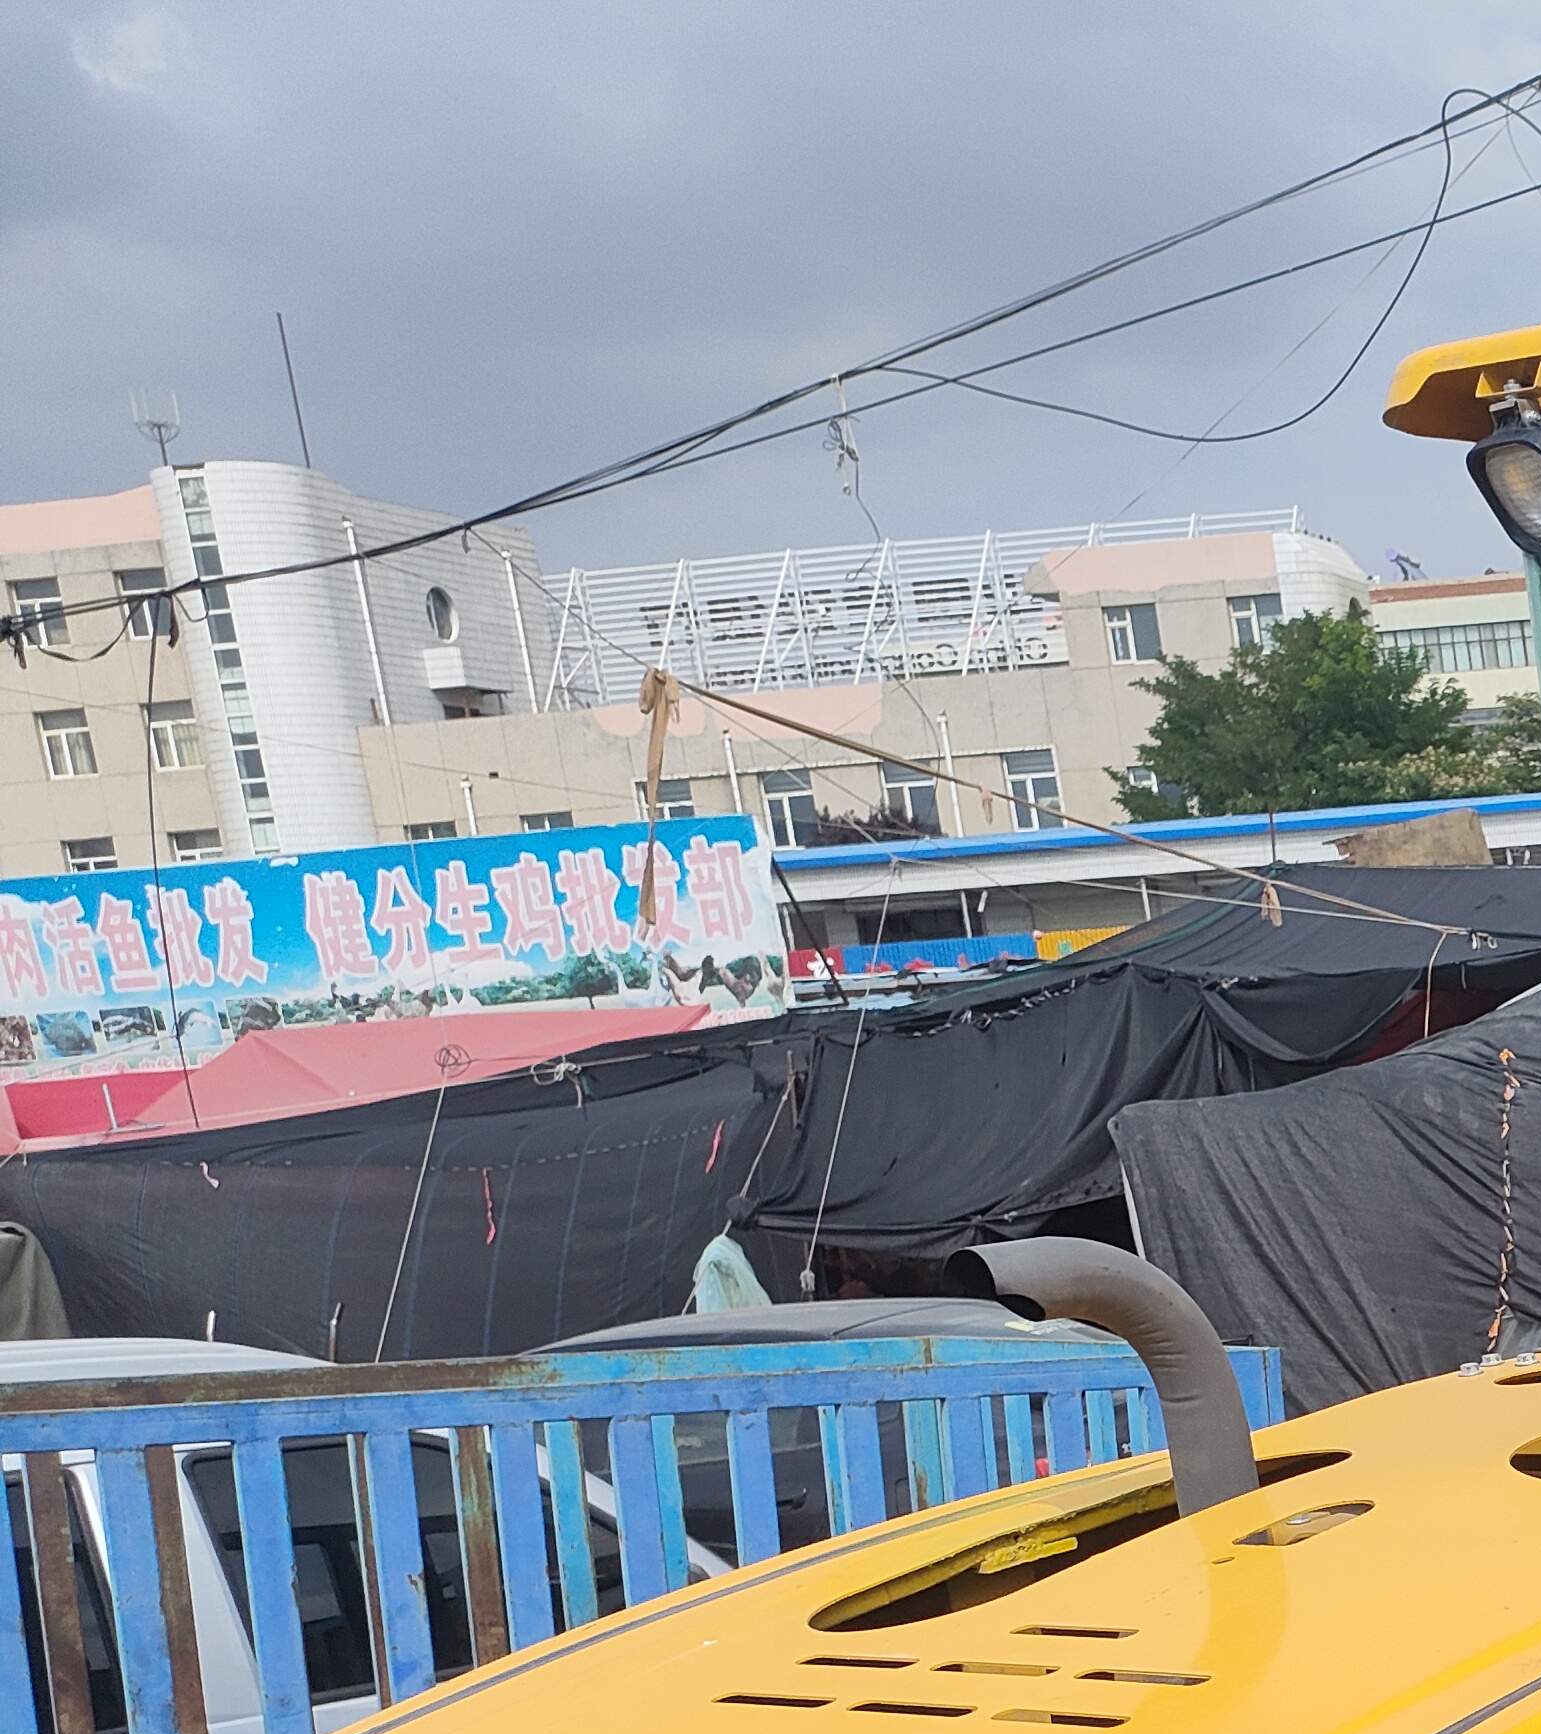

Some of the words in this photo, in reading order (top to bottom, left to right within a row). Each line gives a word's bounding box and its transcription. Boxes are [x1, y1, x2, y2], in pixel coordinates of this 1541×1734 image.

[302, 834, 755, 979] 健分生鸡批发部
